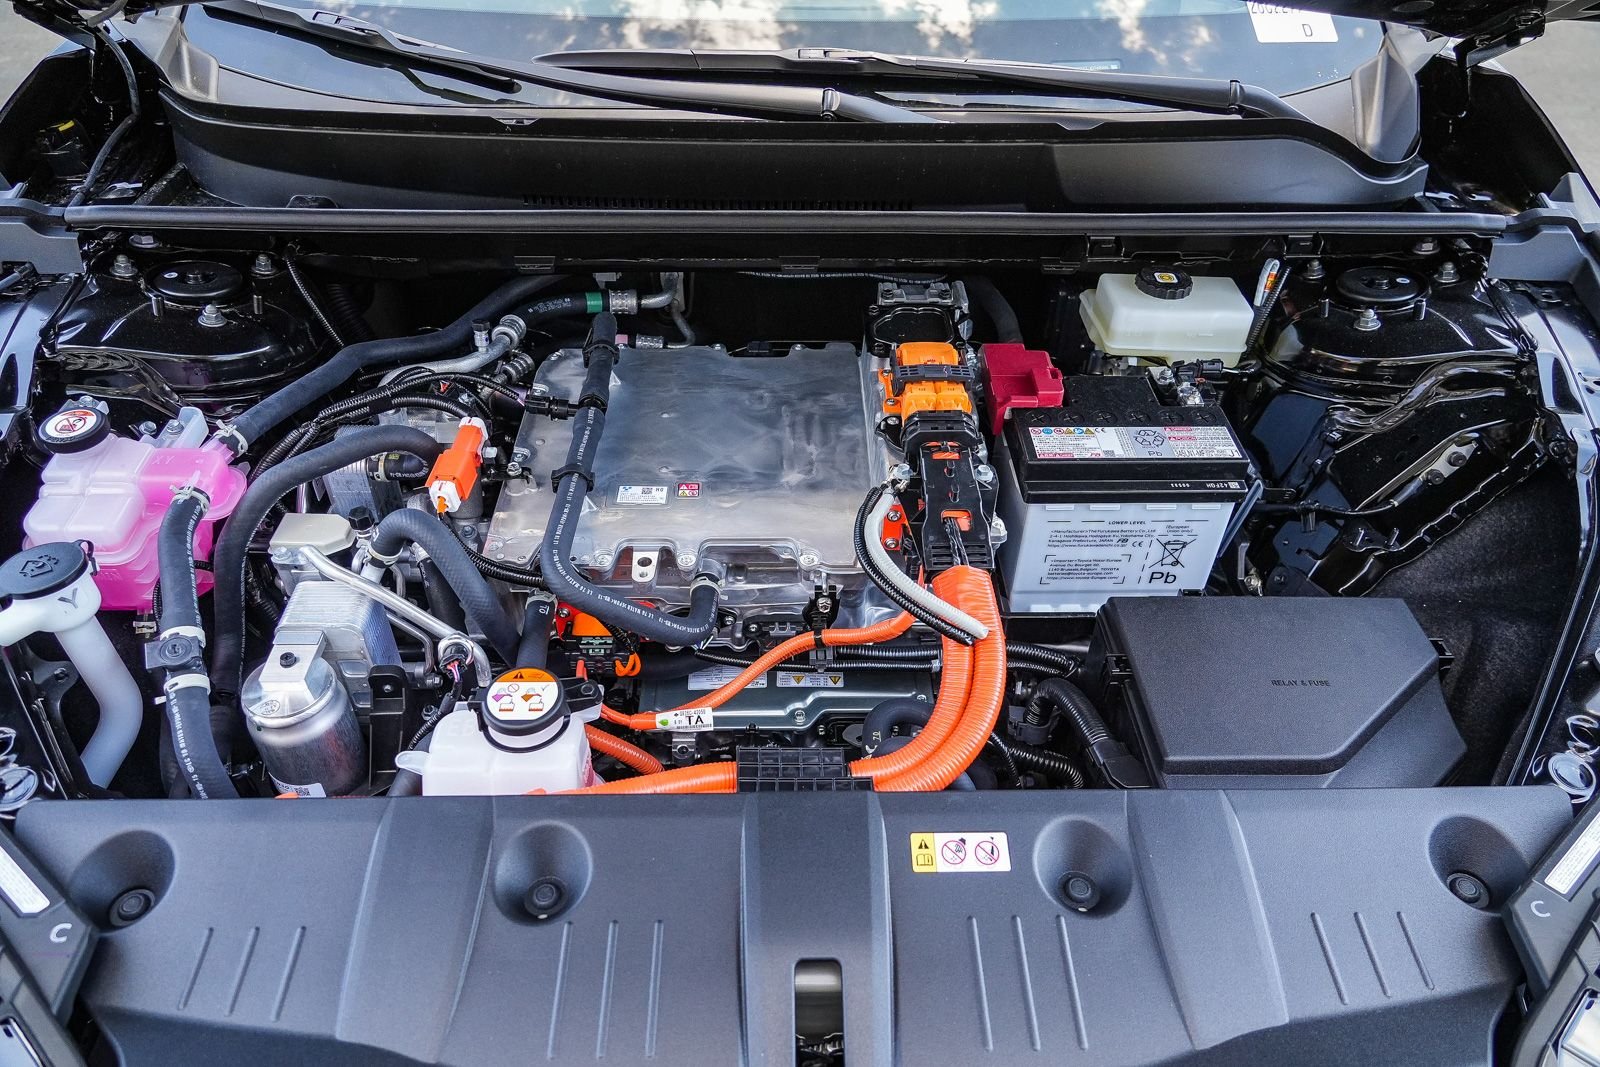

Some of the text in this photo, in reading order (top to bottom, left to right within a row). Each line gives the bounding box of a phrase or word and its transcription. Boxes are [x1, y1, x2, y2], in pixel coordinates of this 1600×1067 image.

[1301, 23, 1313, 37] D
[1148, 571, 1177, 584] Pb
[1270, 679, 1331, 687] RELAY & FUSE
[686, 715, 705, 725] TA
[49, 922, 73, 943] C
